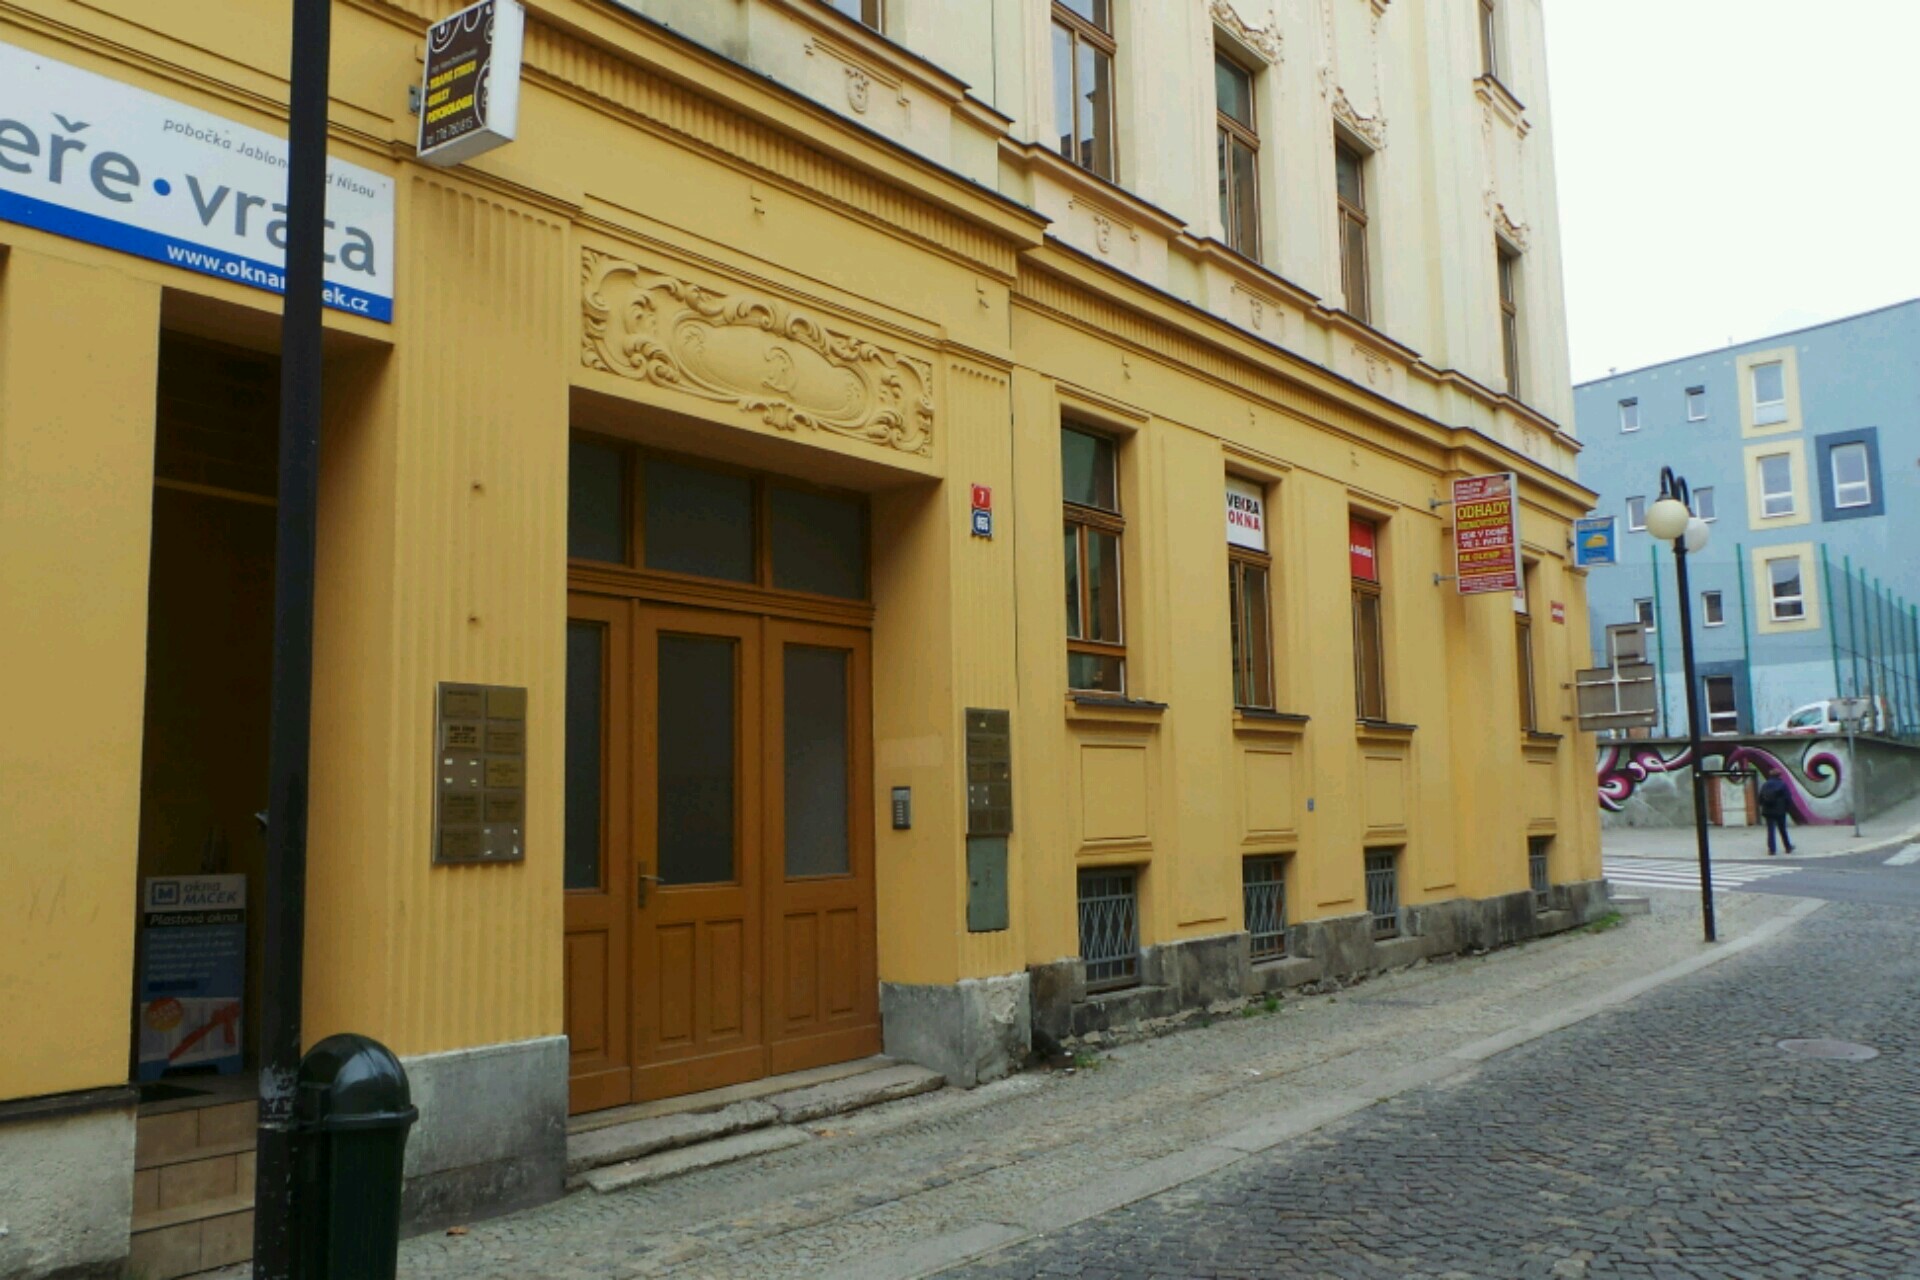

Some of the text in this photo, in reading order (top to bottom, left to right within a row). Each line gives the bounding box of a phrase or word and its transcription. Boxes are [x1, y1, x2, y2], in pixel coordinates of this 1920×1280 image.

[163, 118, 231, 150] pobočka
[236, 142, 289, 168] Jablon
[337, 174, 375, 198] Nisou
[167, 244, 369, 312] www.oknaek.cz
[1226, 493, 1259, 515] VEKRA
[1458, 500, 1508, 519] ODHADY
[1228, 511, 1261, 531] OKNA
[183, 880, 221, 893] okna
[207, 911, 239, 924] okna
